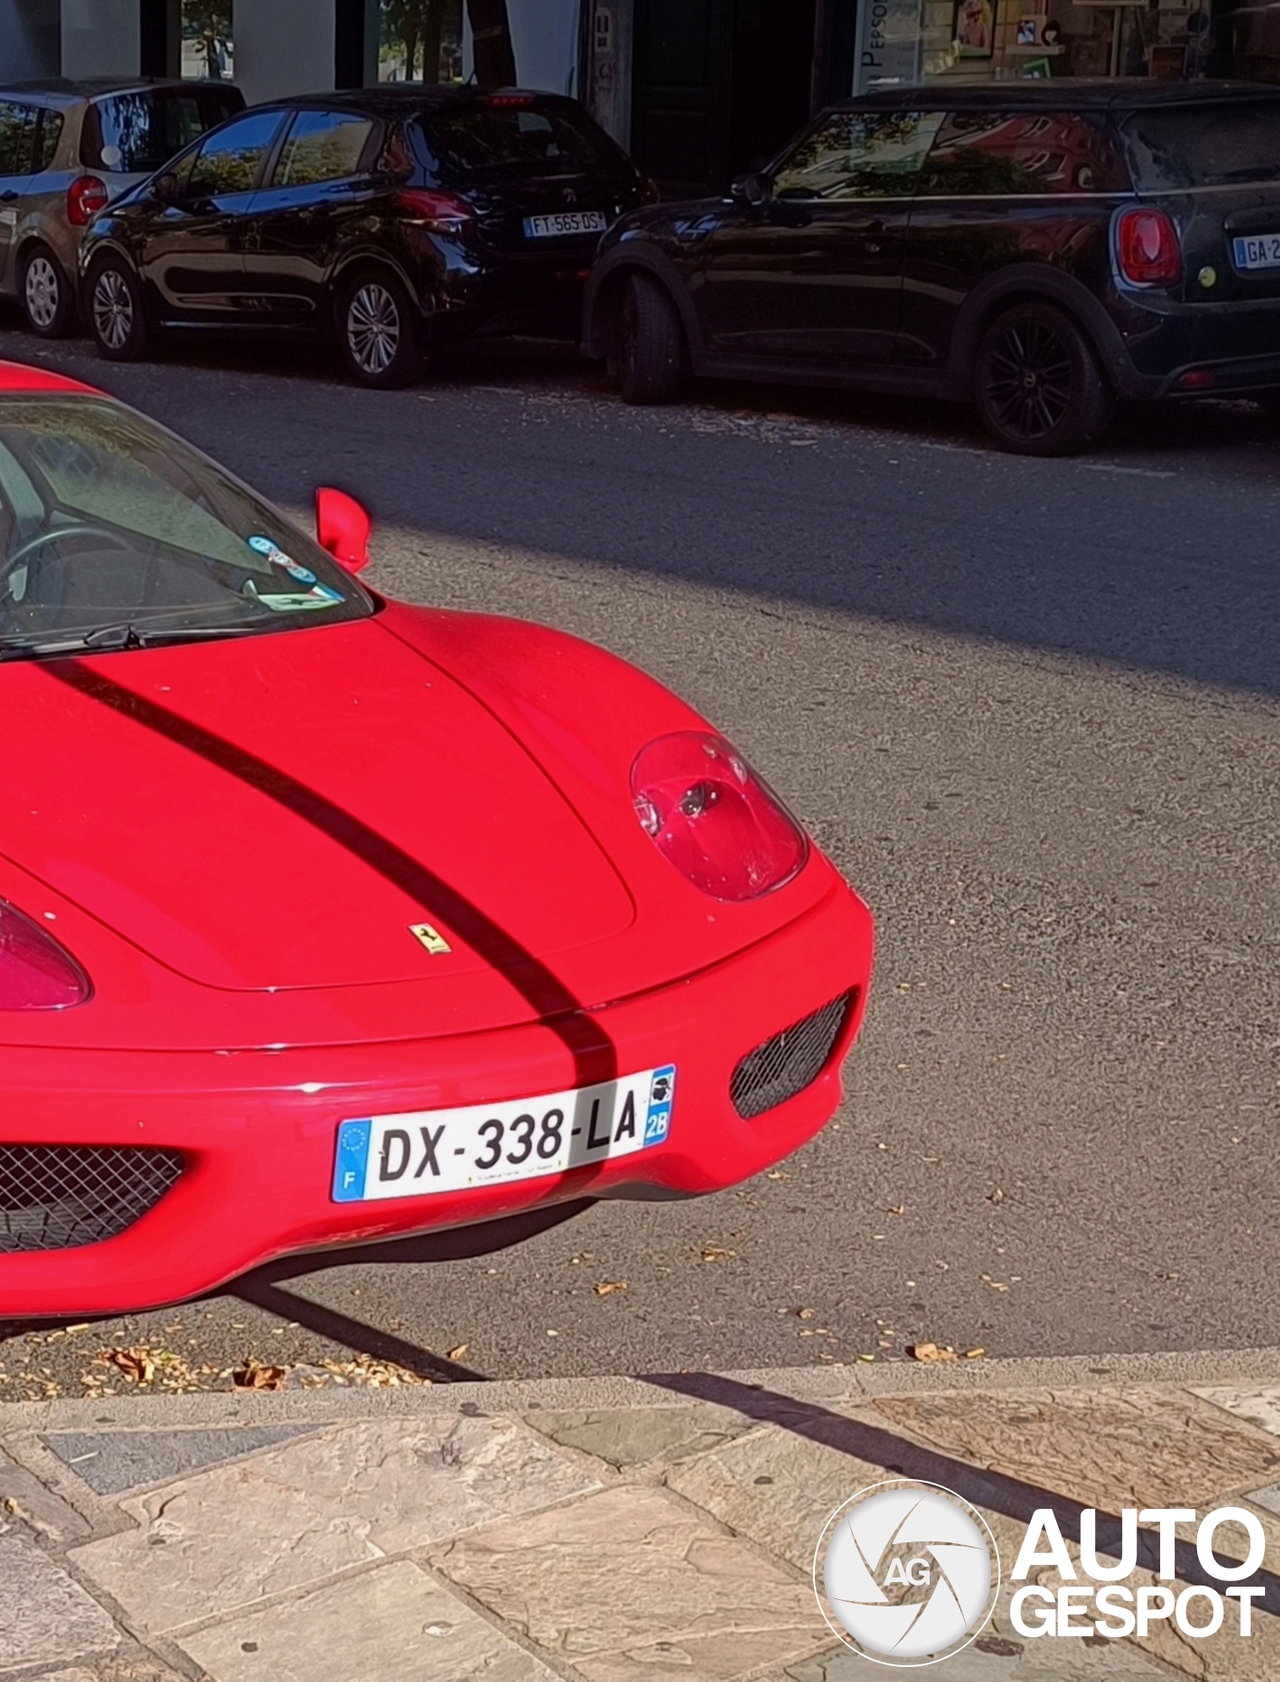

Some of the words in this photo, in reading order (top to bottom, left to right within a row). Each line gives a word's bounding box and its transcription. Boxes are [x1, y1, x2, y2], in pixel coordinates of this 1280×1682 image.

[861, 0, 888, 67] PERSO
[343, 1171, 355, 1189] F
[379, 1090, 636, 1182] DX-338-LA
[646, 1108, 669, 1138] 2B
